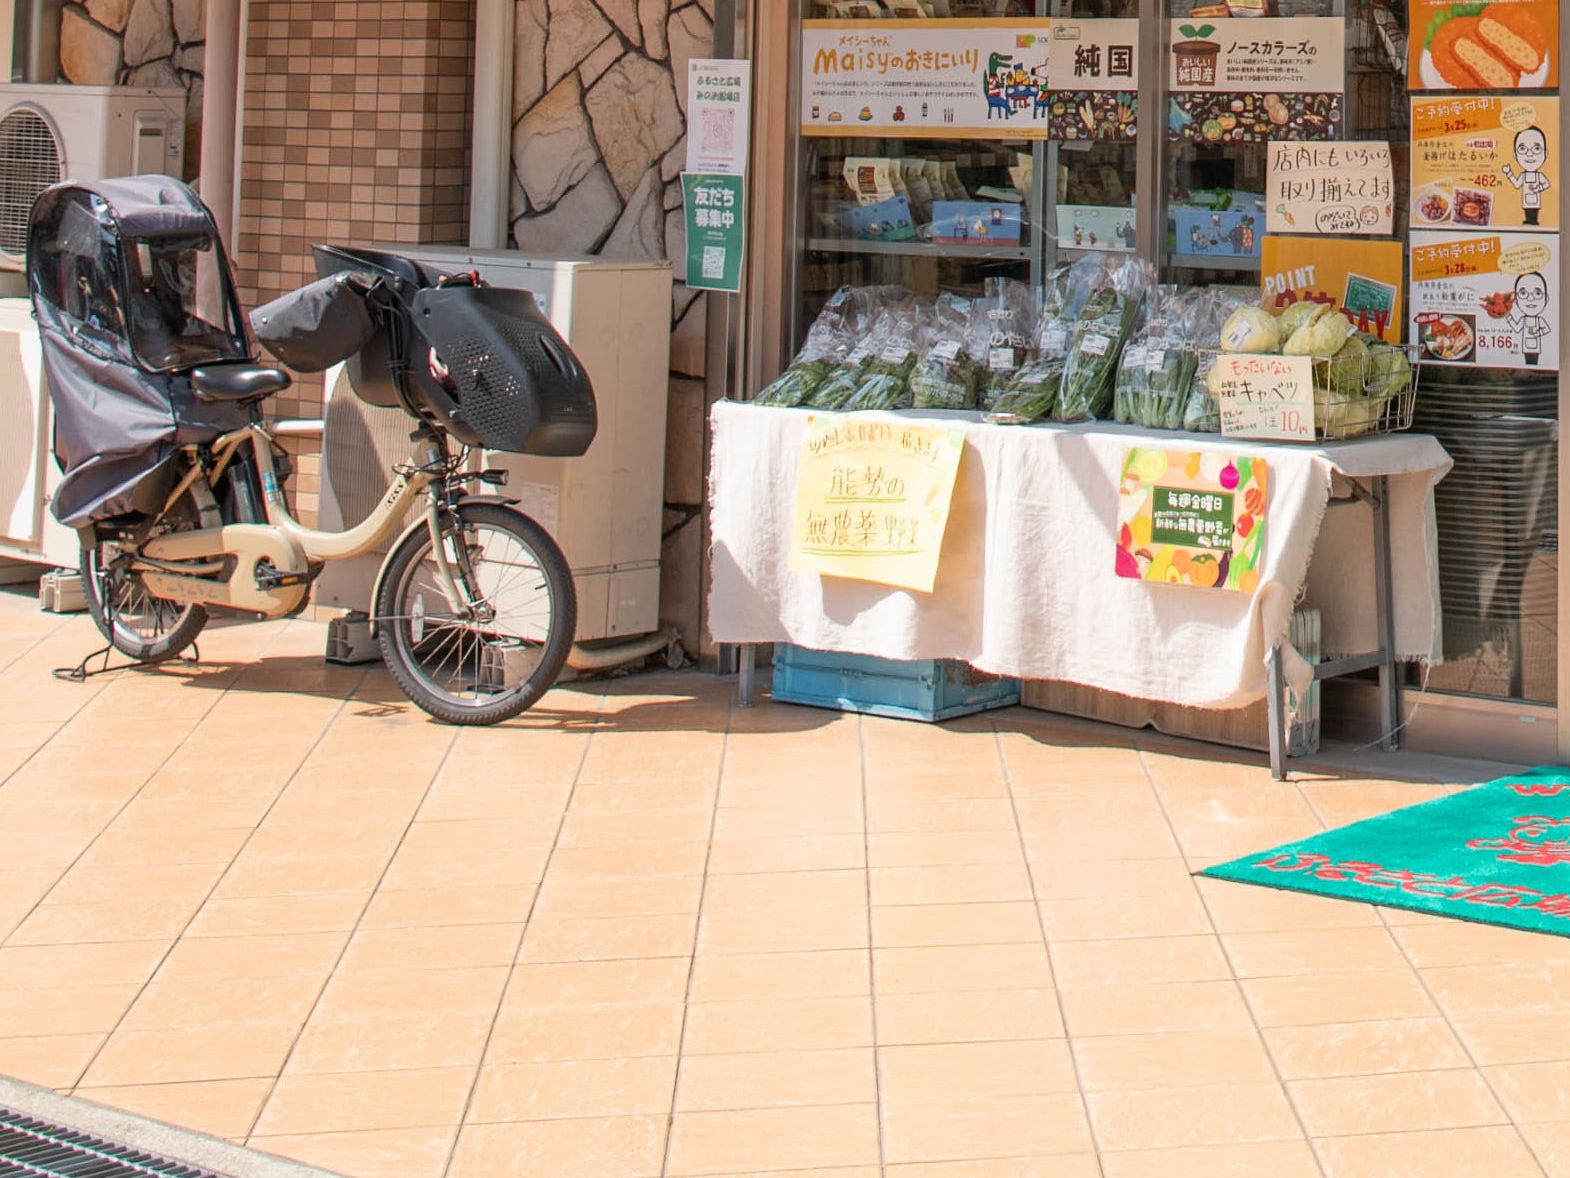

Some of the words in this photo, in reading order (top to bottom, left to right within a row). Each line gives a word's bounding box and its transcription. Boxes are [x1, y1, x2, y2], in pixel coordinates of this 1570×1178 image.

[839, 34, 890, 46] メイシーちゃん
[1227, 40, 1317, 55] ノースカラーズの
[813, 48, 979, 75] Maisyのおきにいり
[1074, 44, 1133, 78] 純国
[696, 76, 741, 86] ふるさと広場
[1179, 67, 1214, 83] 純国産
[694, 187, 735, 207] 友だち
[1281, 176, 1392, 202] 取り揃えてます
[695, 208, 735, 229] 募集中
[1264, 265, 1315, 295] POINT
[1240, 379, 1298, 402] キャベツ
[1168, 491, 1223, 512] 毎週金曜日
